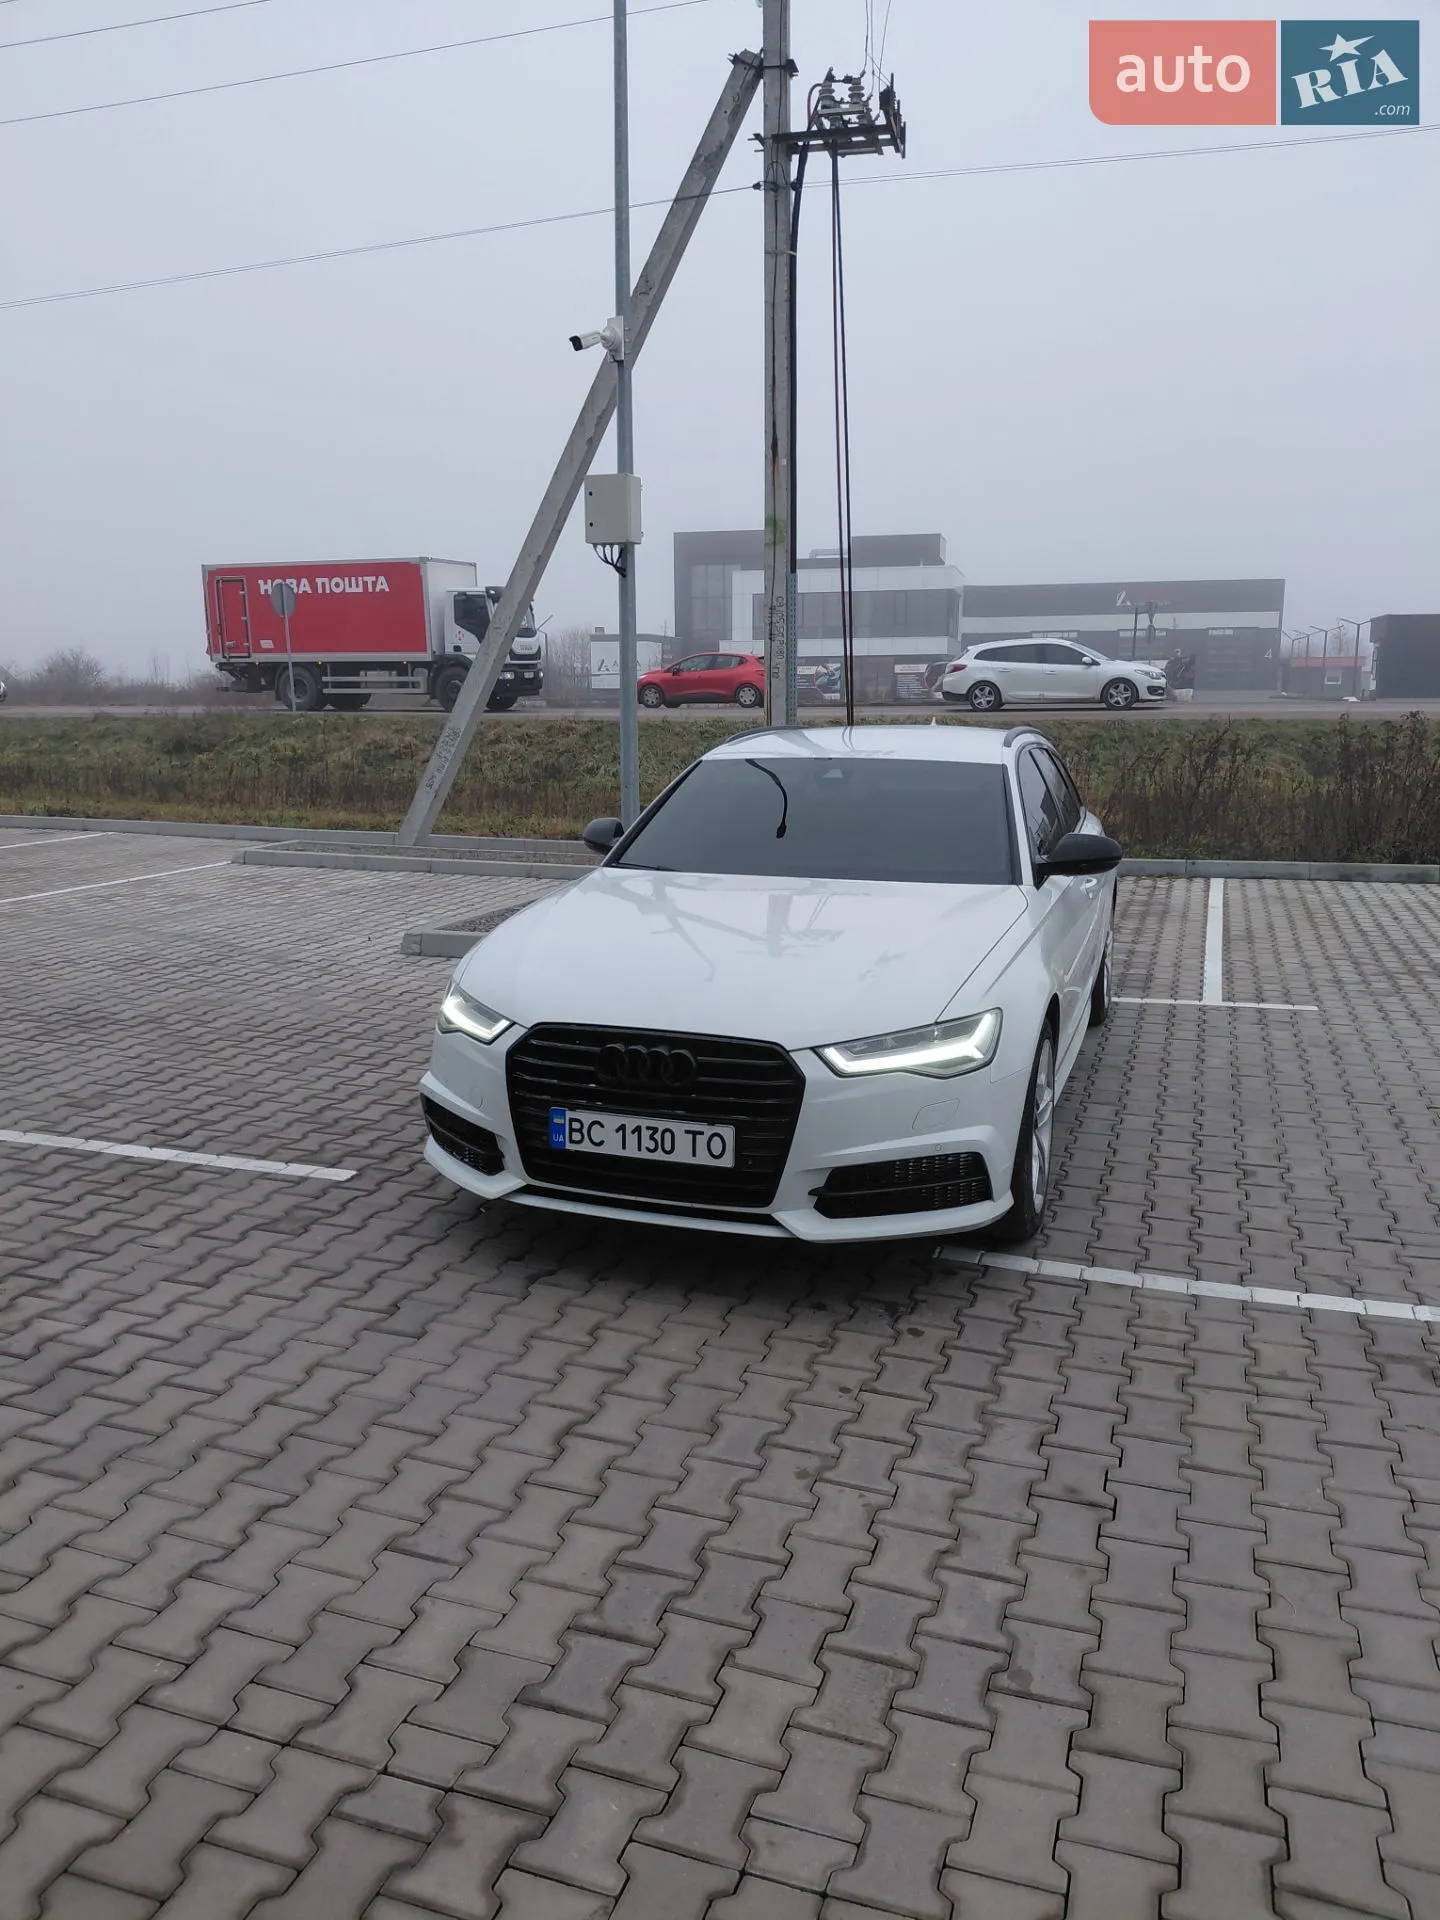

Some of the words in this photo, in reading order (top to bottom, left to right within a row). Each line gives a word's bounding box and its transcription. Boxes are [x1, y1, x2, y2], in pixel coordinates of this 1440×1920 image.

[257, 578, 312, 595] НВА
[315, 575, 390, 594] ПОШТА
[1263, 648, 1273, 659] 4
[552, 1134, 565, 1143] UA
[567, 1116, 606, 1148] BC
[615, 1123, 676, 1155] 1130
[684, 1129, 727, 1160] TO
